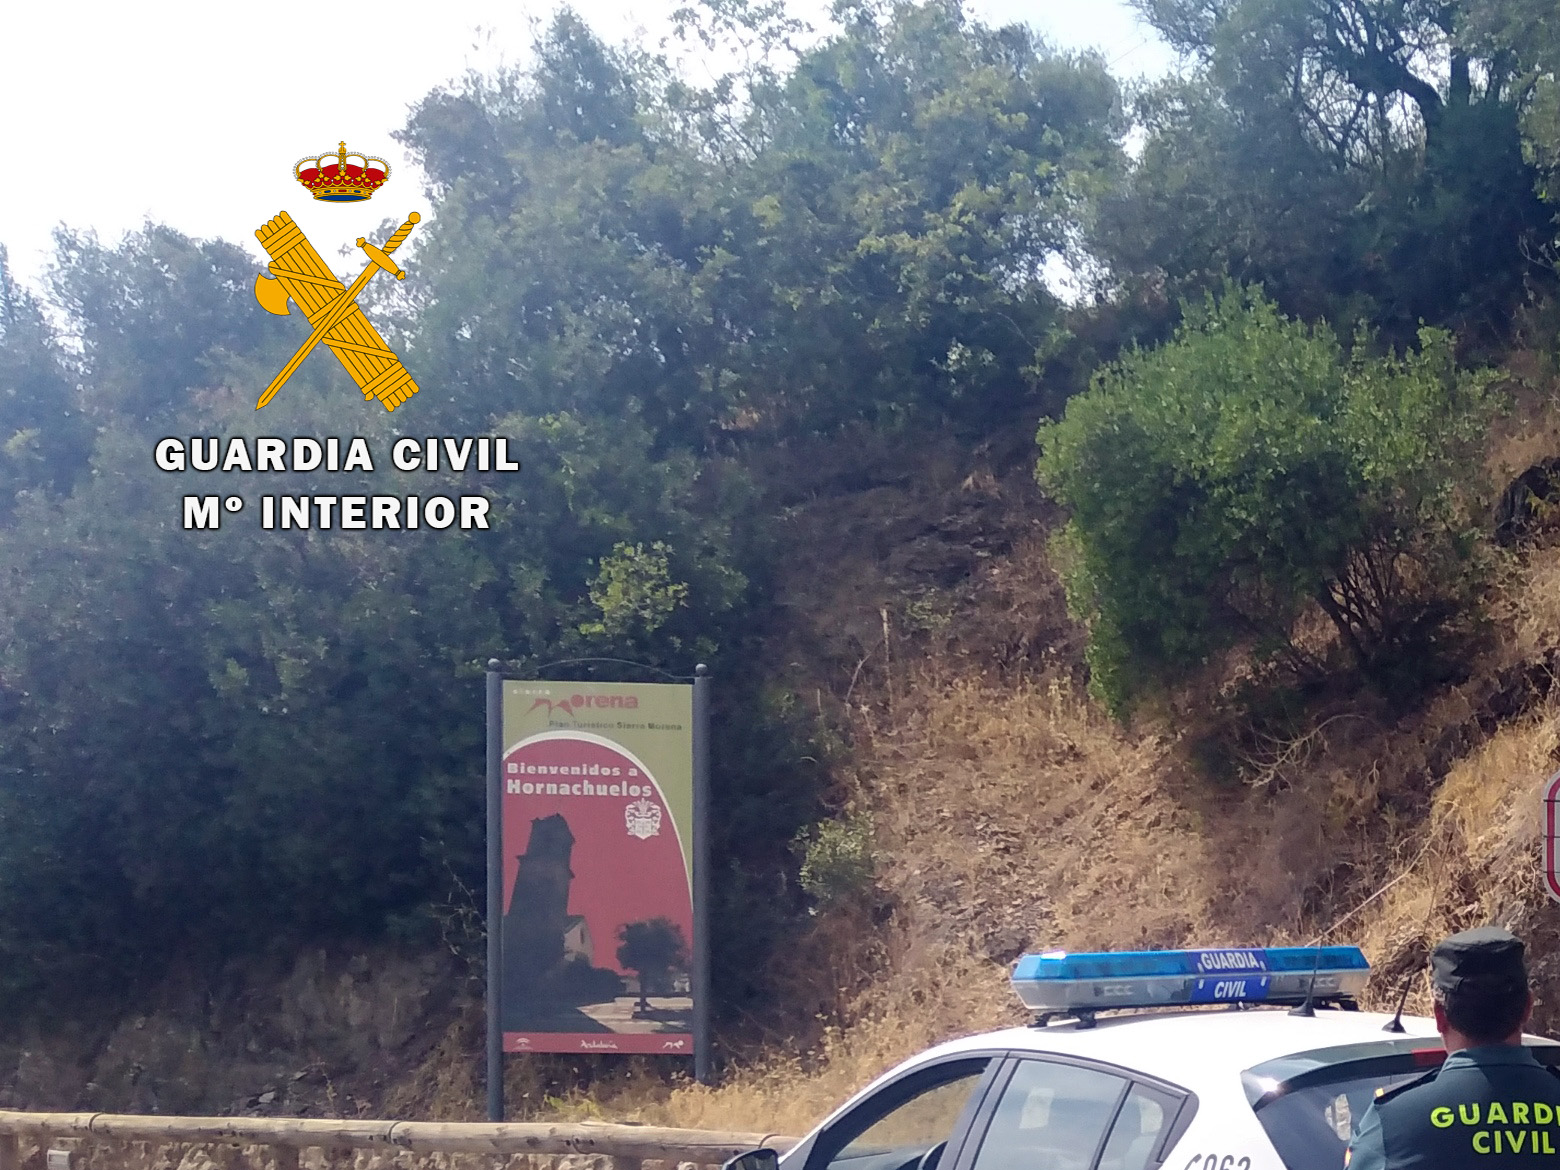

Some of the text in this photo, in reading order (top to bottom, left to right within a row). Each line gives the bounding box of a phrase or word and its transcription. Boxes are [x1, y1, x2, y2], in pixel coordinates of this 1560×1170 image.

[507, 763, 638, 777] Bienvenidos a
[507, 779, 652, 797] Hornachuelos
[1200, 952, 1260, 971] GUARDIA
[1214, 981, 1247, 998] CIVIL
[1472, 1130, 1556, 1154] CIVIL
